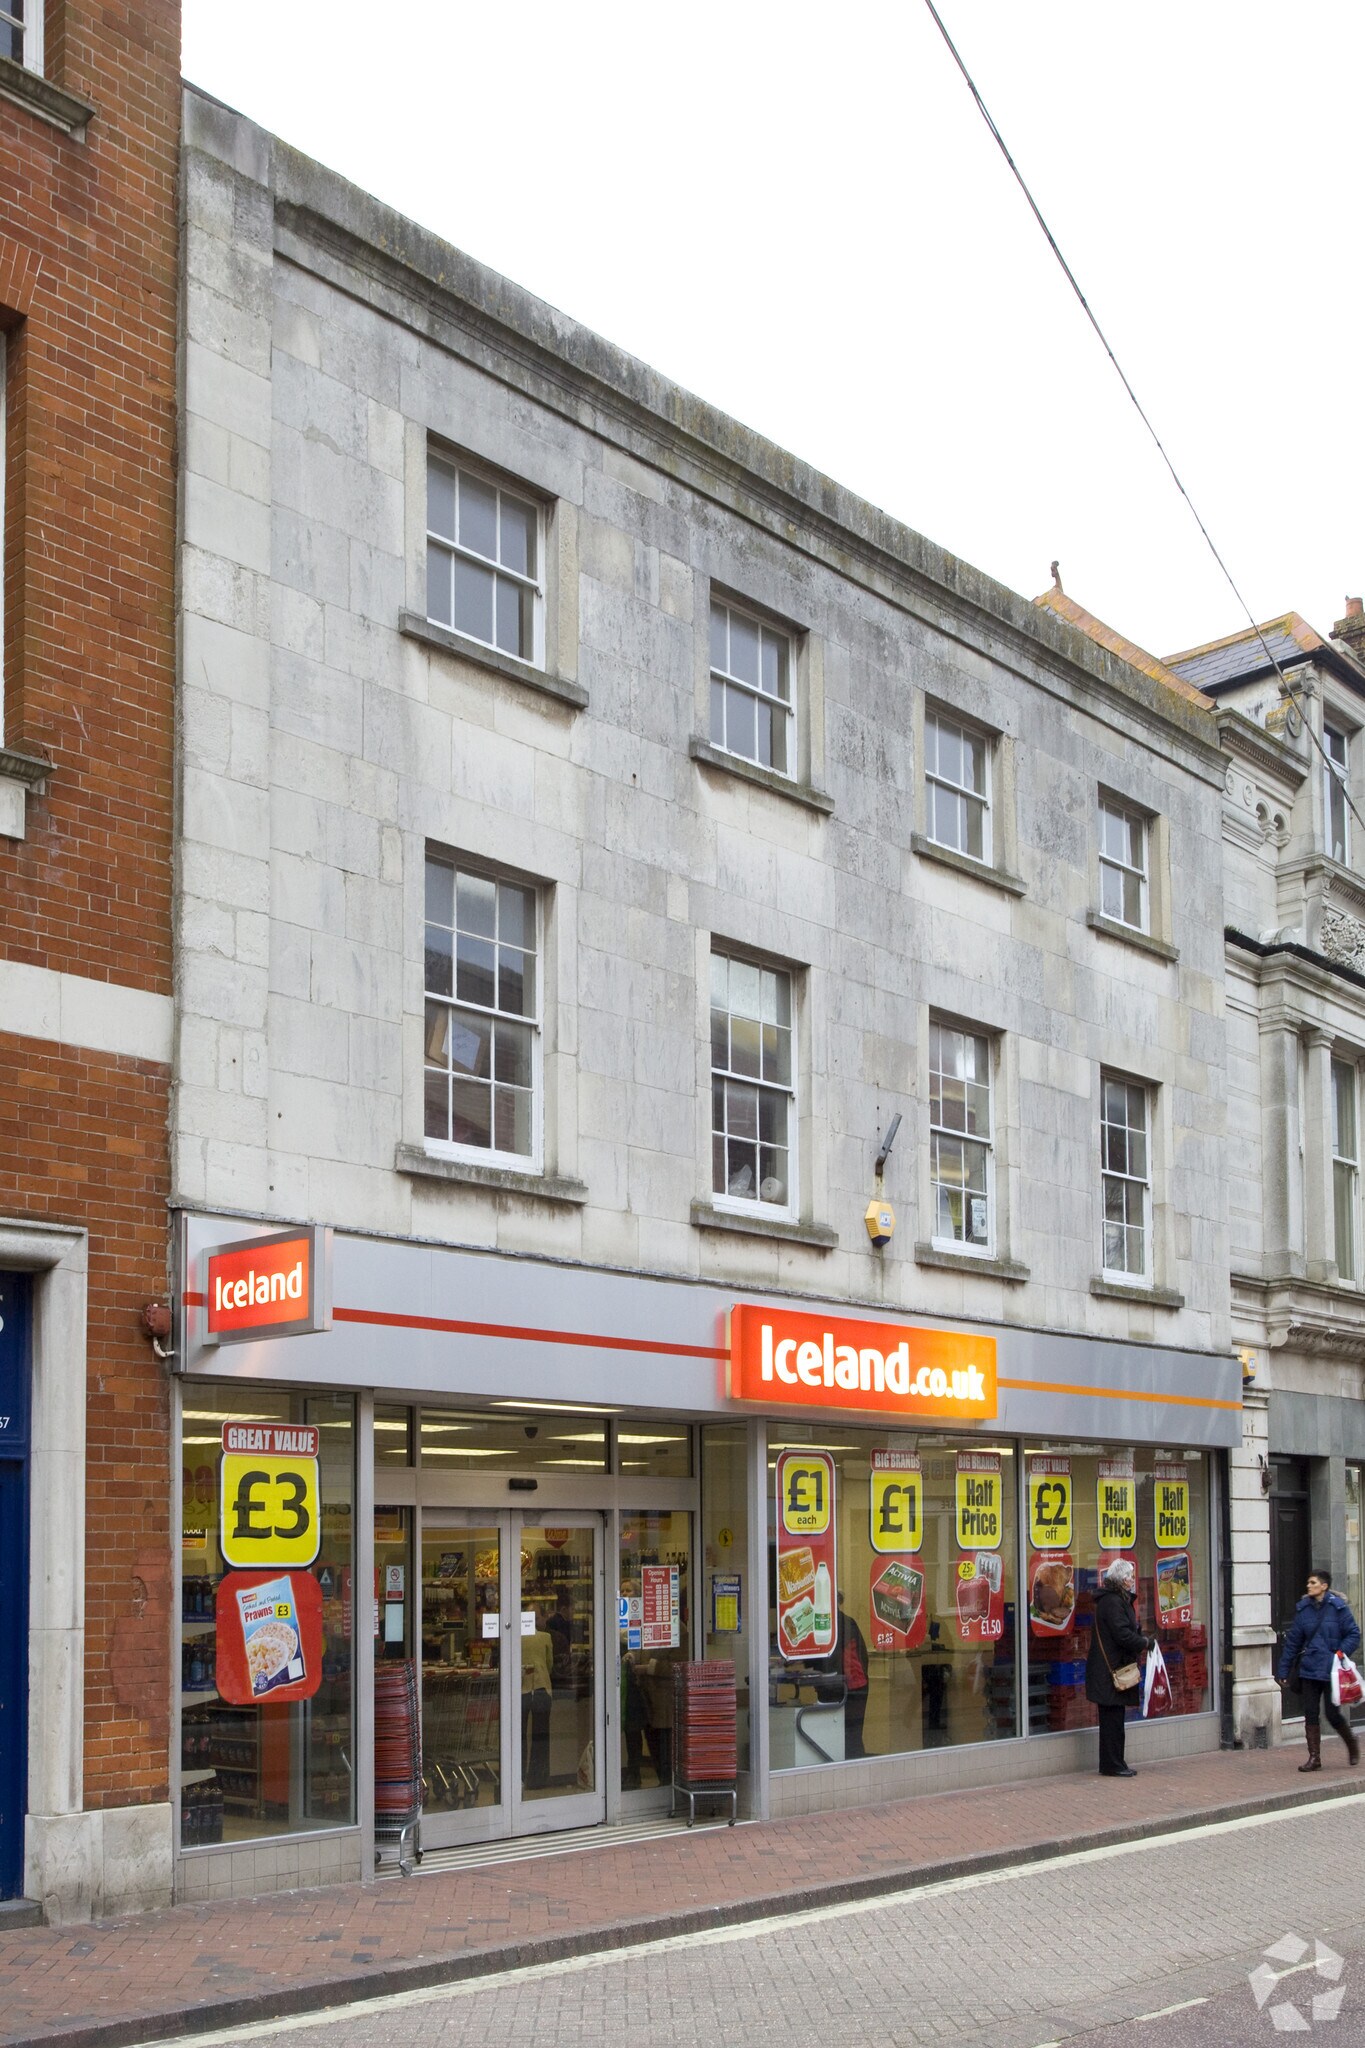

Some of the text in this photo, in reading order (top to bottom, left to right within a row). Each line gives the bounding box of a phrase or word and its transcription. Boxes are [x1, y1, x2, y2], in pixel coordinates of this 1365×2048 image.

[215, 1261, 302, 1311] Iceland
[761, 1324, 985, 1401] Iceland.co.uk
[228, 1427, 315, 1453] GREAT VALUE
[874, 1453, 889, 1468] BIG
[890, 1454, 920, 1470] BRANDS
[958, 1454, 970, 1468] BIG
[971, 1454, 1000, 1470] BRANDS
[1032, 1458, 1070, 1474] GREAT VALUE
[788, 1470, 823, 1512] £1
[966, 1479, 994, 1507] Half
[1105, 1486, 1128, 1512] Half
[1162, 1486, 1184, 1511] Half
[232, 1470, 310, 1539] £3
[879, 1484, 916, 1534] £1
[1035, 1482, 1068, 1526] £2
[797, 1515, 817, 1525] each
[962, 1508, 997, 1536] Price
[1102, 1513, 1132, 1538] Price
[1159, 1512, 1186, 1537] Price
[1045, 1527, 1058, 1540] off
[888, 1566, 918, 1586] ACTIVIA
[244, 1606, 274, 1622] Prawns
[278, 1605, 289, 1616] £3
[1180, 1609, 1191, 1622] £2
[981, 1620, 1001, 1635] £1.50
